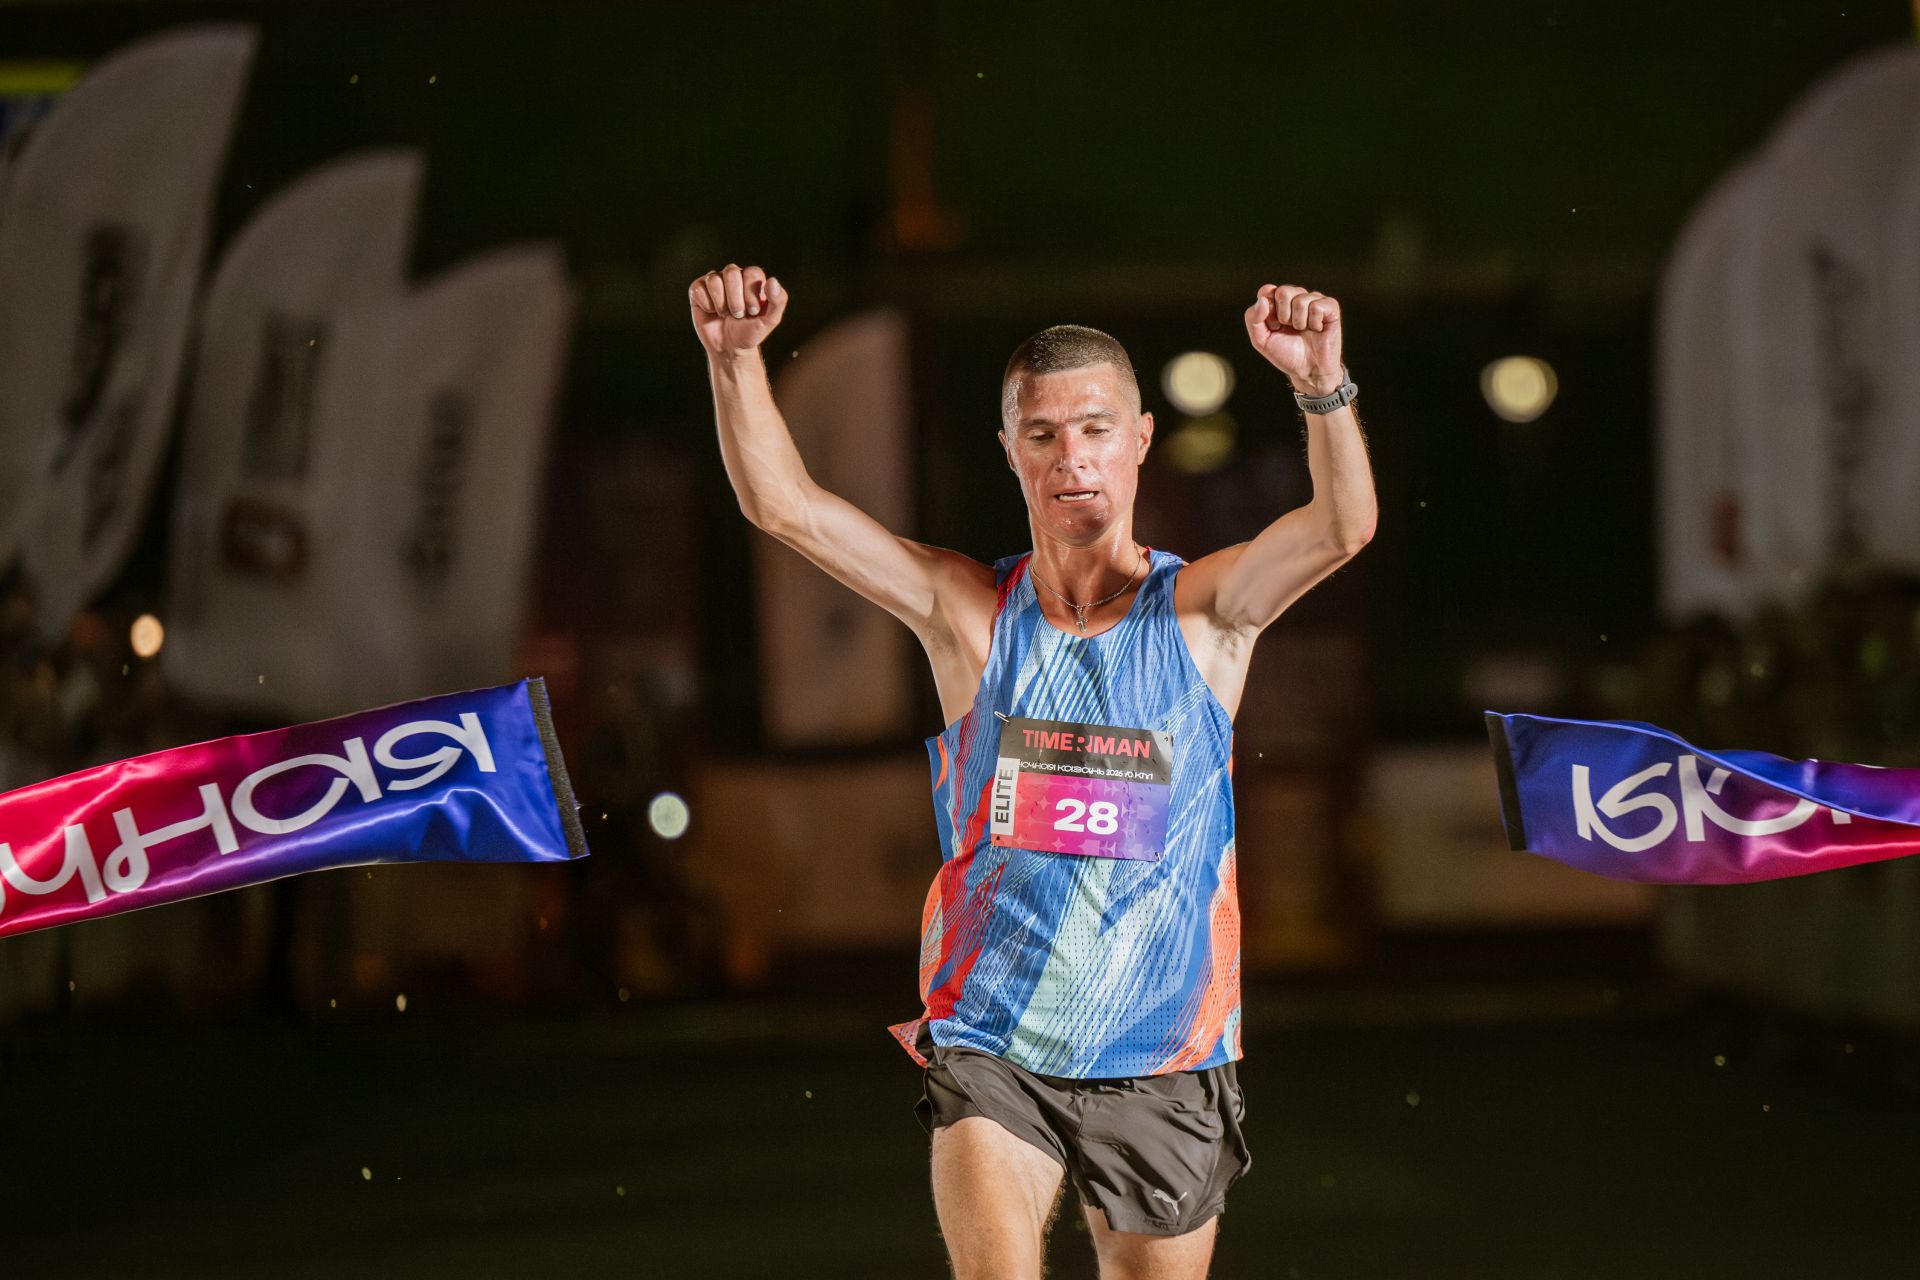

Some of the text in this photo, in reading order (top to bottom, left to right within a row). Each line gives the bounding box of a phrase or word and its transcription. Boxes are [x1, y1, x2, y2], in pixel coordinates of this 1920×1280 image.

[1022, 729, 1151, 759] TIMERMAN
[1106, 769, 1124, 777] 2026
[995, 768, 1014, 824] ELITE
[1053, 798, 1119, 835] 28
